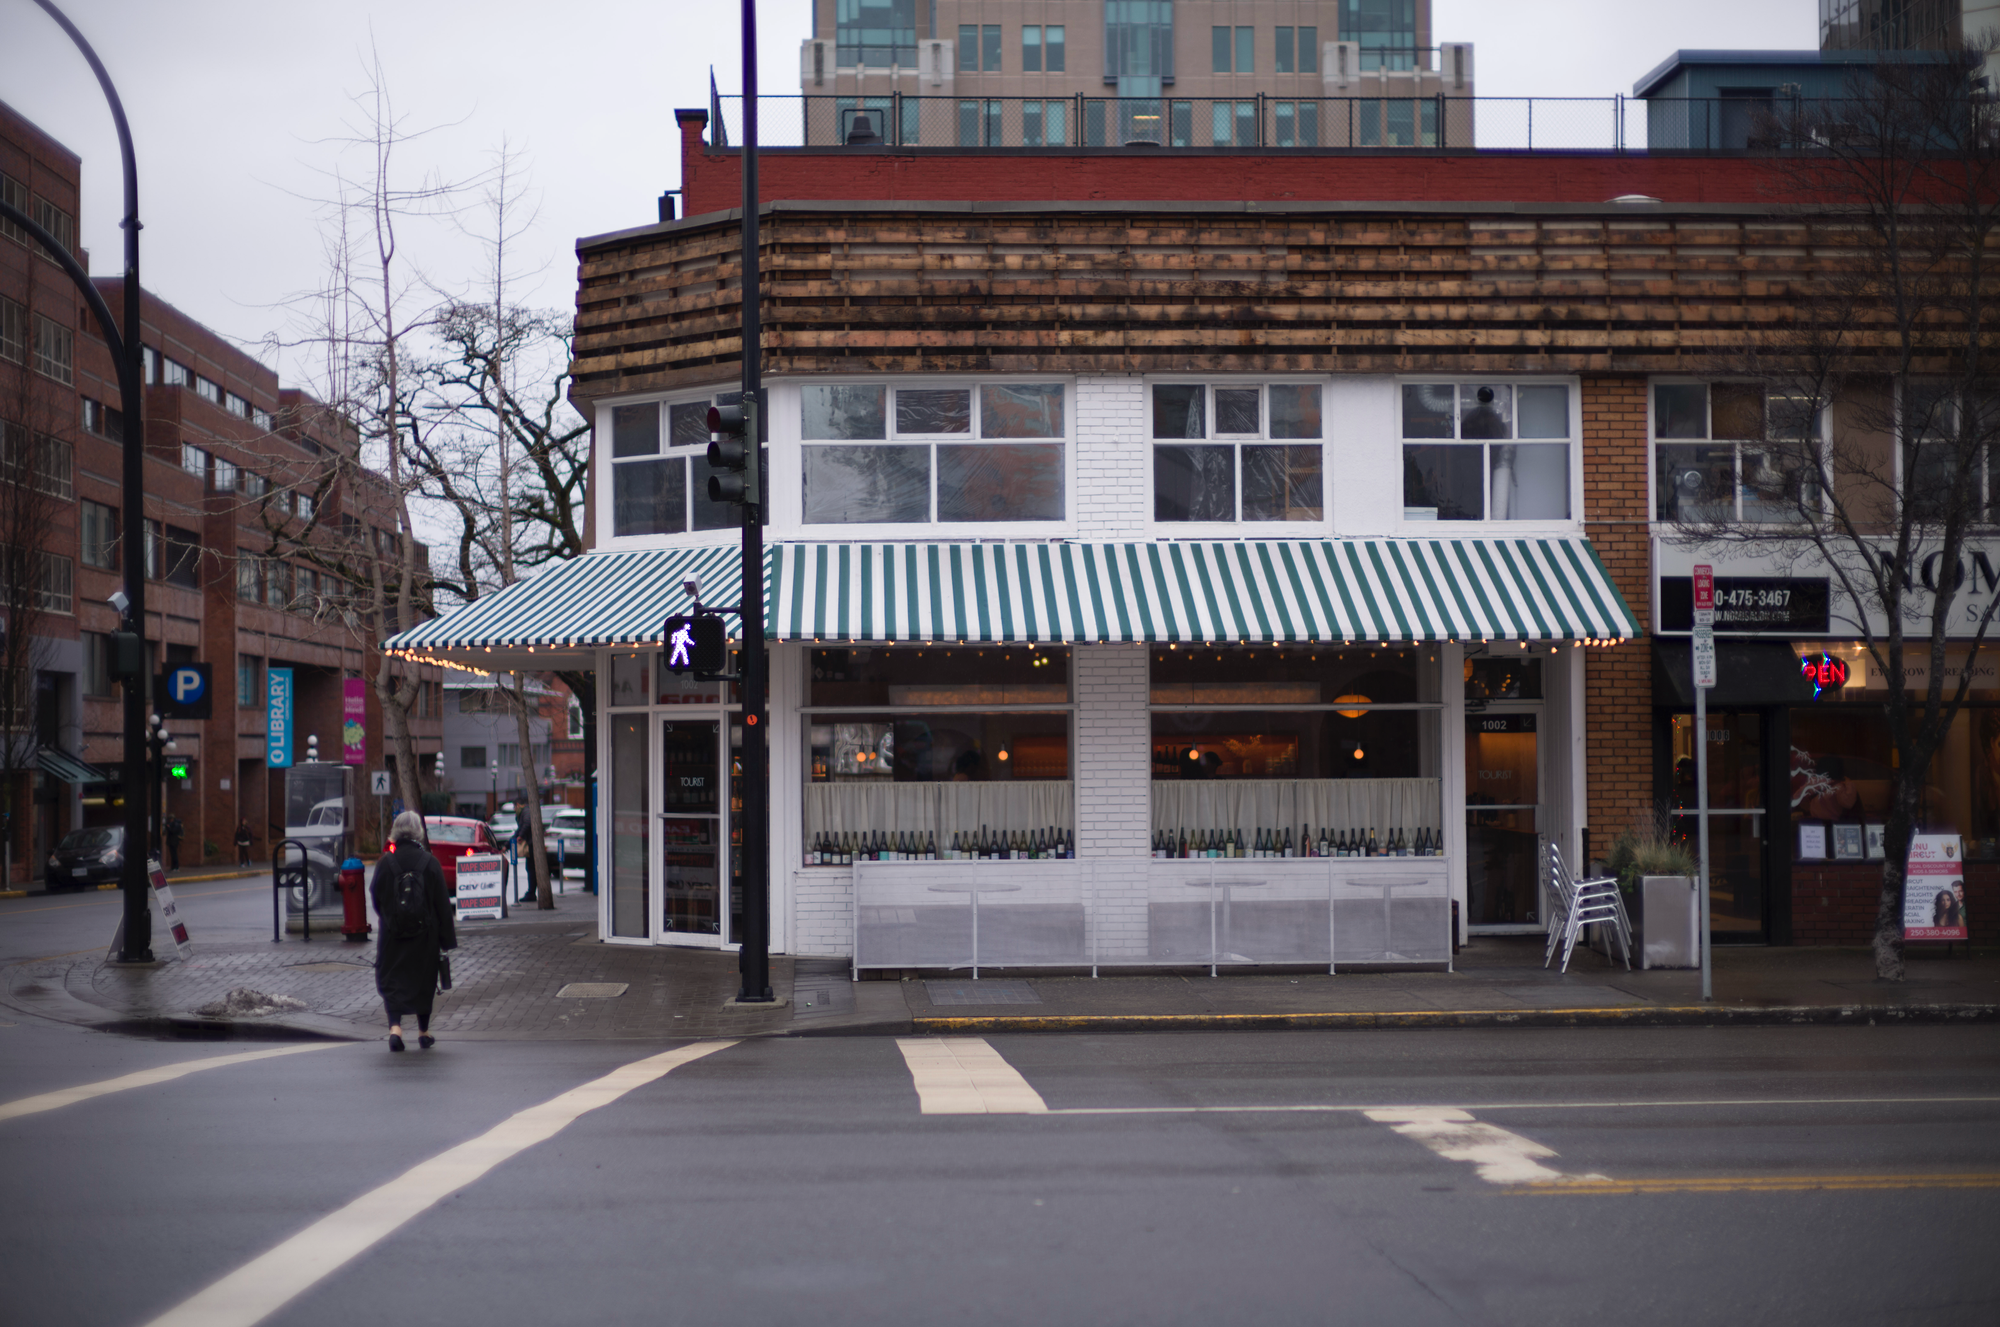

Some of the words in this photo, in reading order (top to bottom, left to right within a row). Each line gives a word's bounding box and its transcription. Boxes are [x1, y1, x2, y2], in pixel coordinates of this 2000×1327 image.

[1700, 591, 1709, 600] ZONE
[1713, 590, 1791, 606] 0-475-3467
[1966, 603, 2000, 622] SA
[1700, 643, 1710, 653] ZONE
[1803, 658, 1845, 687] PEN
[1871, 667, 1926, 676] EYROW
[177, 670, 200, 700] P
[681, 680, 698, 689] 1002
[271, 673, 285, 747] LIBRARY
[1482, 720, 1507, 730] 1002
[1478, 770, 1512, 779] TOURIST
[680, 777, 704, 787] TOURIST
[1908, 851, 1937, 859] IRCUT
[460, 863, 479, 872] VAPE
[480, 861, 498, 871] SHOP
[460, 899, 479, 908] VAPE
[480, 897, 498, 907] SHOP
